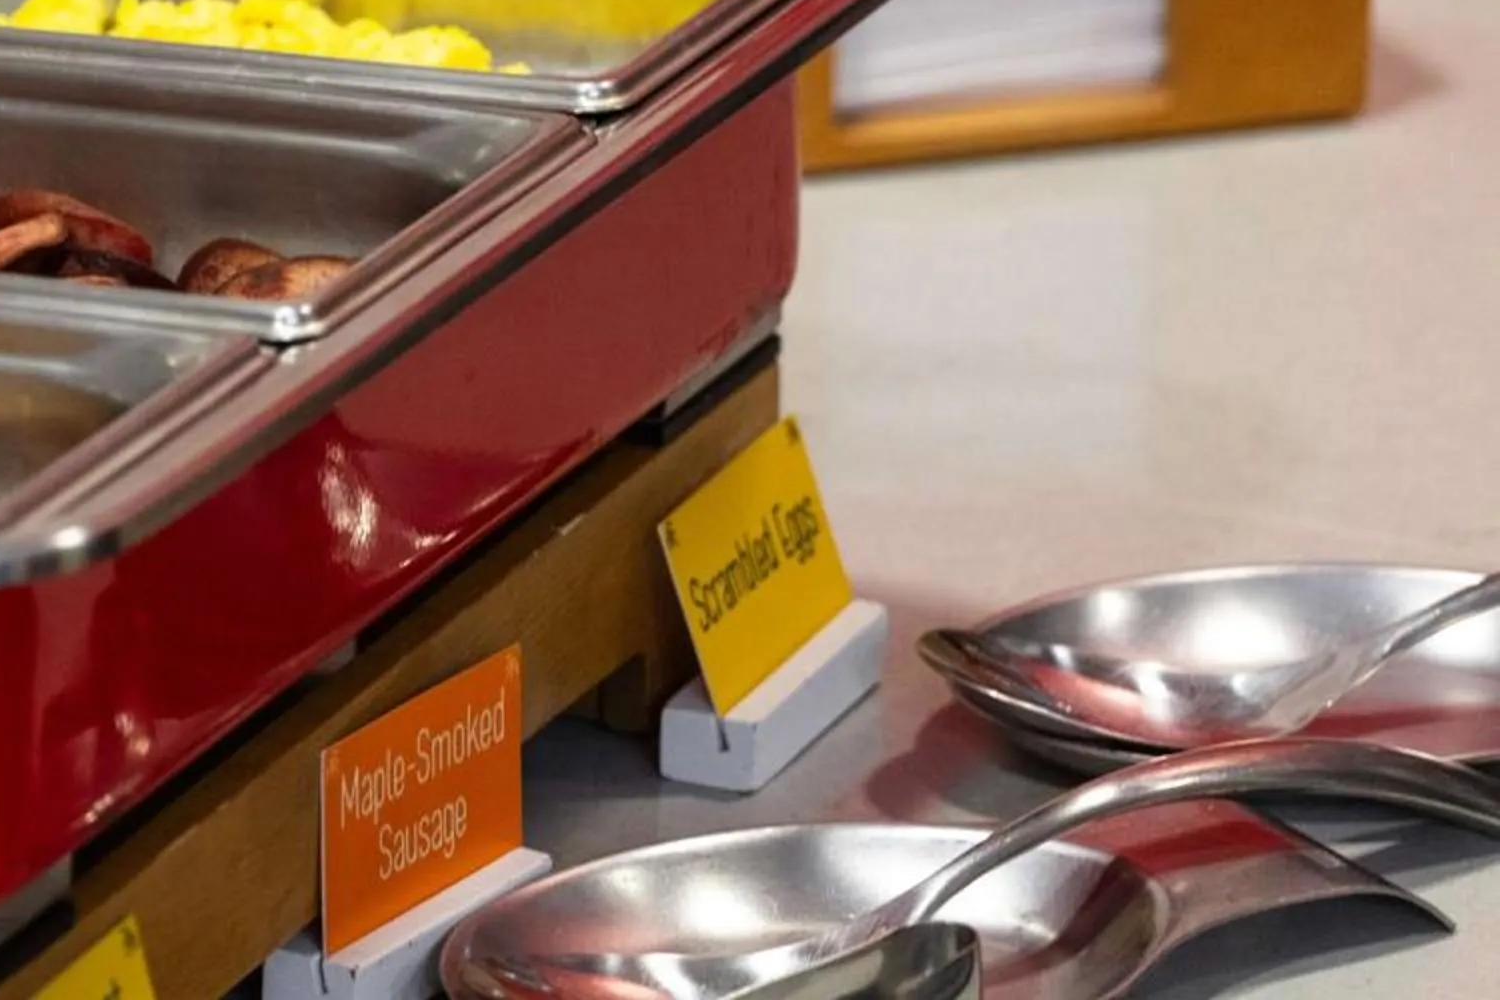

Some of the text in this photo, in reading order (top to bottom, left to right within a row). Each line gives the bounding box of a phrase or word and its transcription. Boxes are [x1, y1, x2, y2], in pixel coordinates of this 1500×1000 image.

[689, 496, 821, 632] Scrambled Eggs
[339, 686, 506, 829] Maple-Smoked
[378, 795, 468, 881] Sausage
